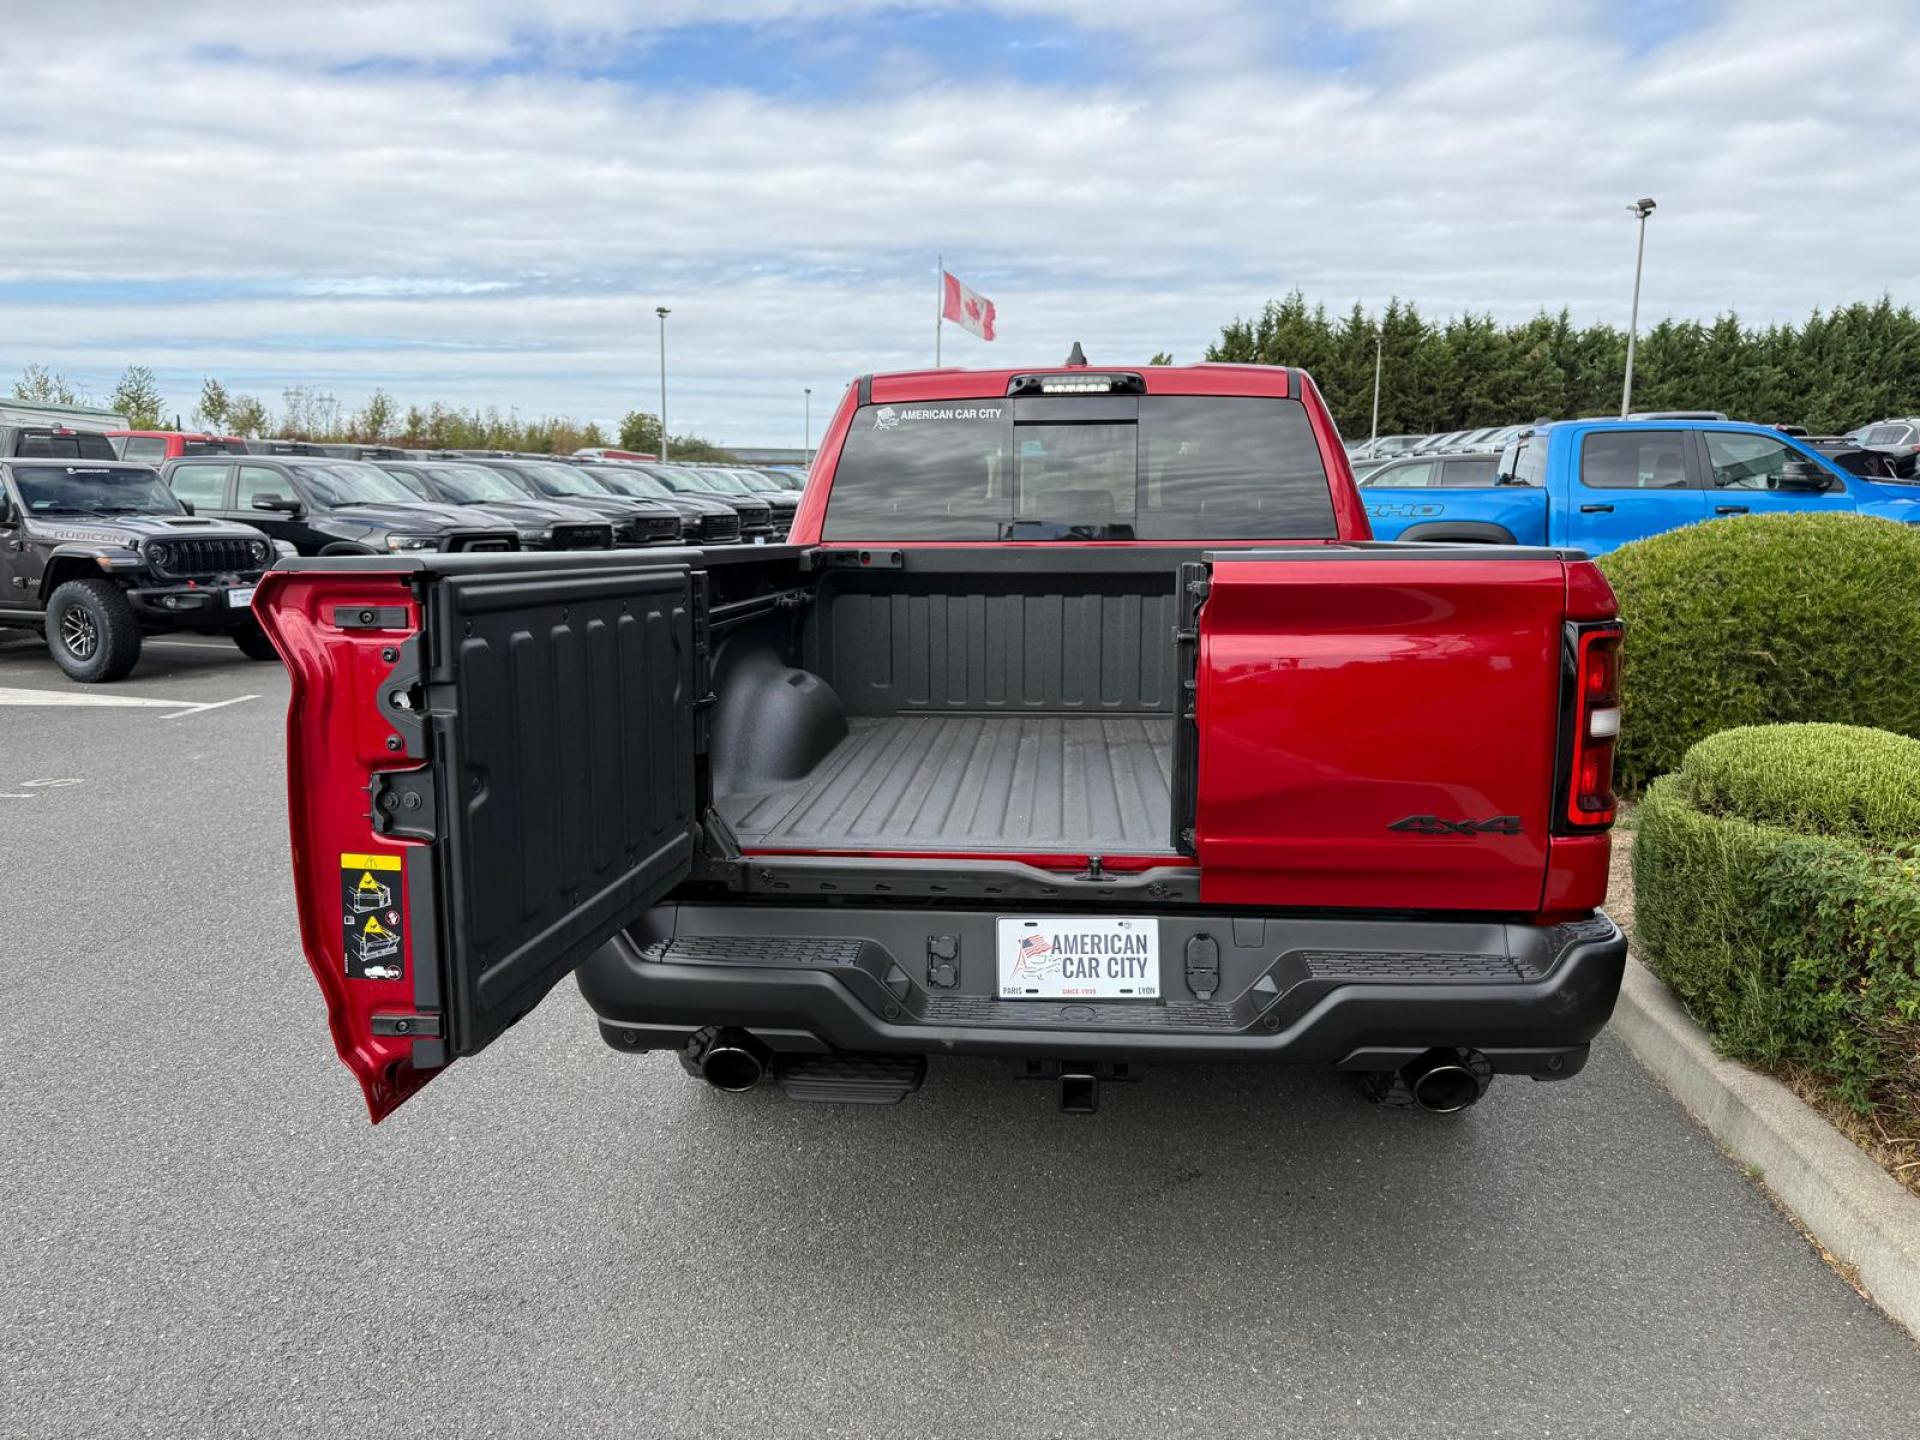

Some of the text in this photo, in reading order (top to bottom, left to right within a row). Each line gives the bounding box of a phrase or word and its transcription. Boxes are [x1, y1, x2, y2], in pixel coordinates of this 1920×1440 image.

[900, 408, 1002, 420] AMERICAN CAR CITY
[54, 529, 125, 543] RUBICON
[1387, 814, 1525, 836] 4x4
[1051, 934, 1148, 955] AMERICAN
[1062, 957, 1148, 979] CAR CITY
[1002, 986, 1023, 995] PARIS
[1138, 986, 1156, 995] LYON
